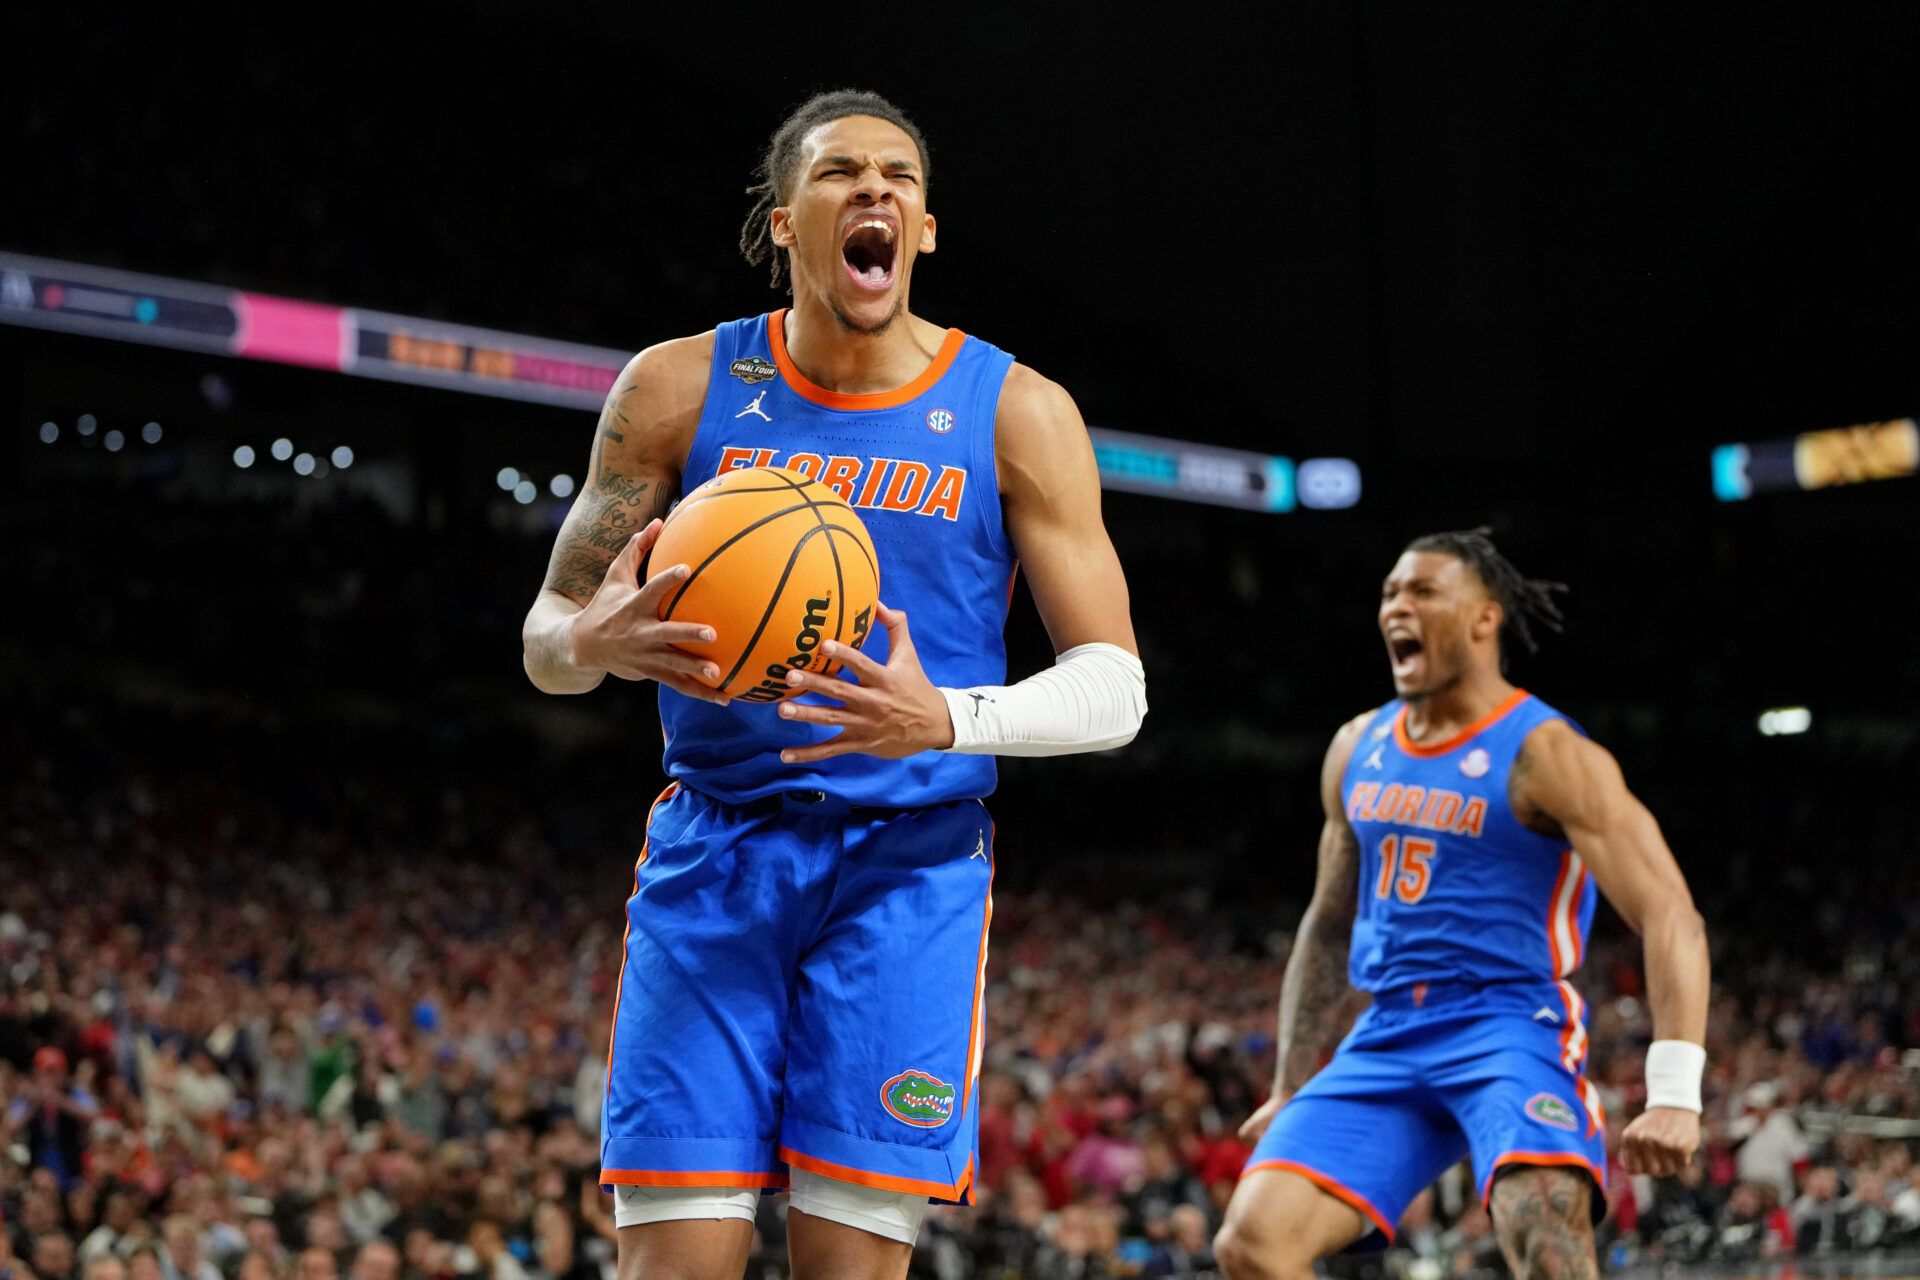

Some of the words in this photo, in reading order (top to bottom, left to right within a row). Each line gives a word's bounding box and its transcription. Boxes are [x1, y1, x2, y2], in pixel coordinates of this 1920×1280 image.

[733, 363, 754, 373] FINAL
[754, 366, 776, 376] FOUR
[929, 410, 953, 431] SEC
[736, 597, 830, 702] Wilson
[1347, 781, 1488, 838] FLORIDA
[1376, 833, 1437, 905] 15
